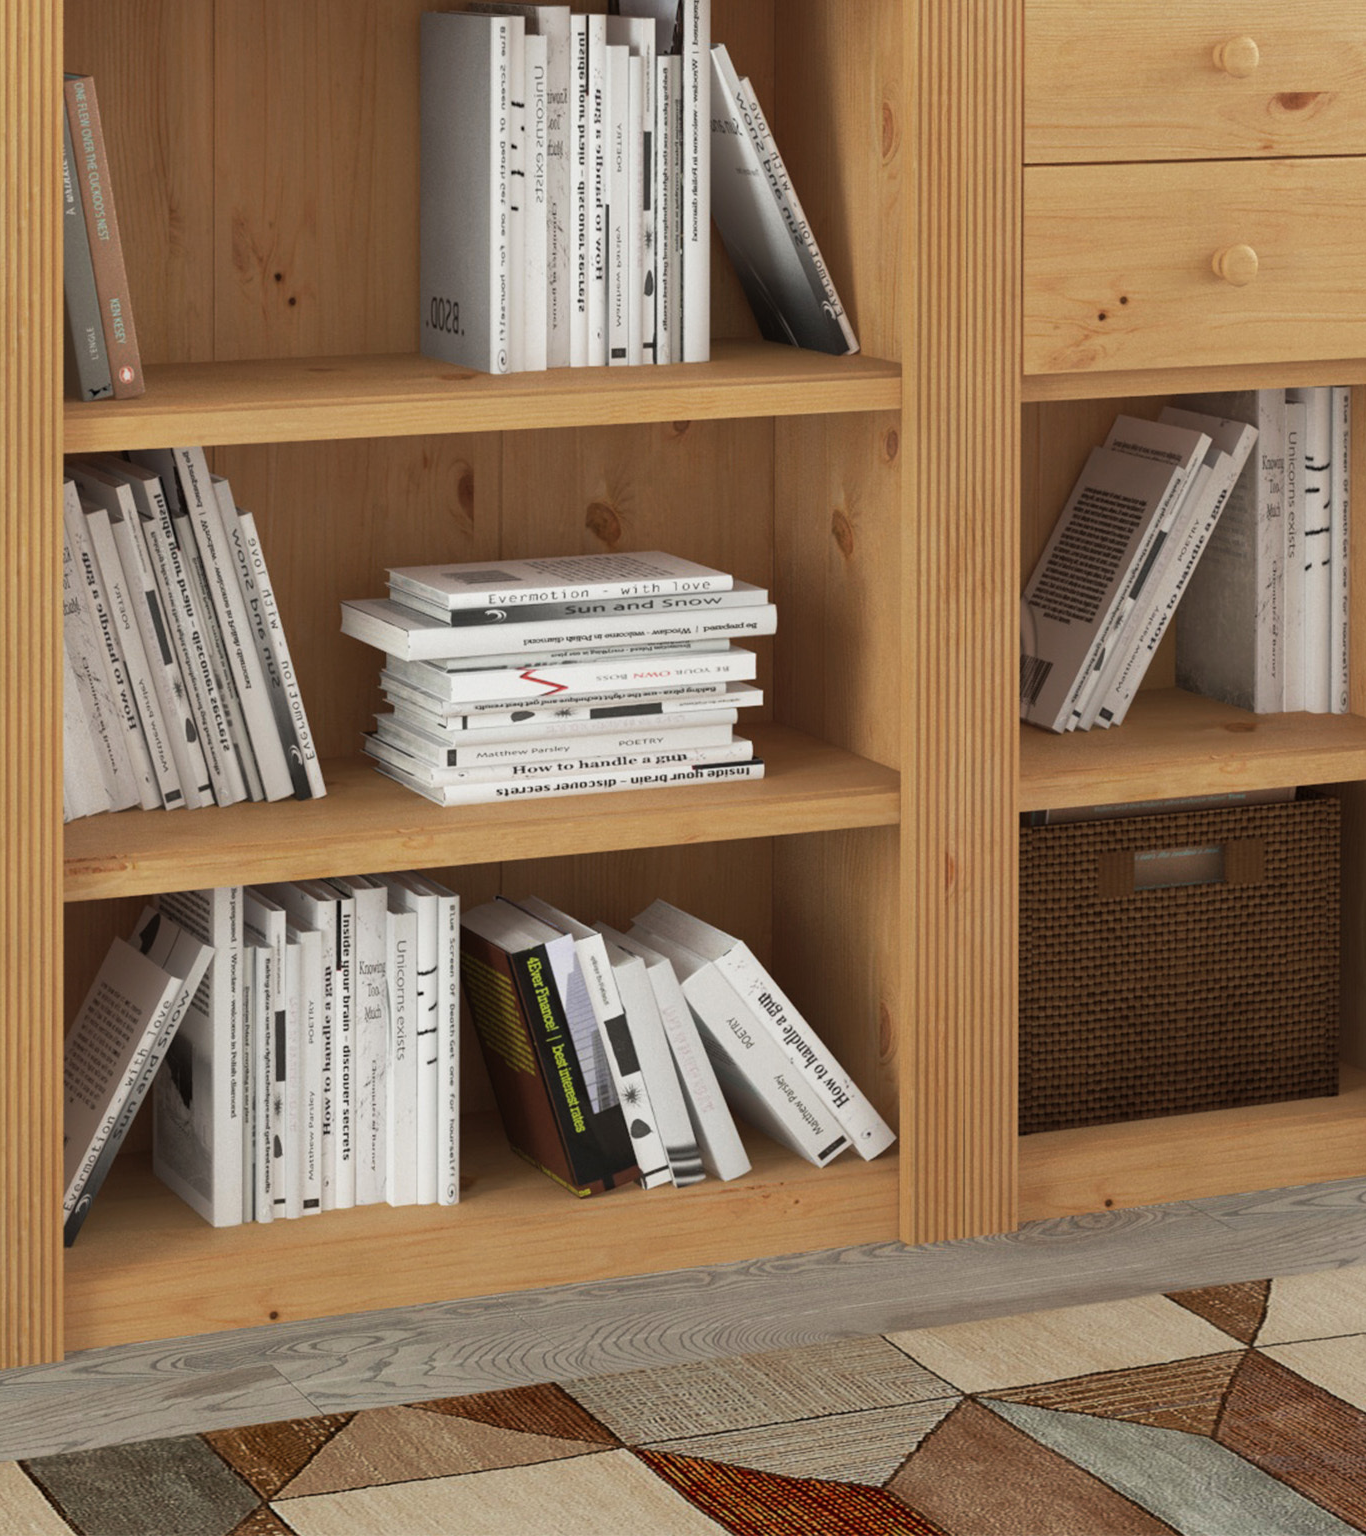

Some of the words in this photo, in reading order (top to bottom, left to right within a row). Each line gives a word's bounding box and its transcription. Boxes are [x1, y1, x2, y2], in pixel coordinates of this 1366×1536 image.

[73, 81, 86, 103] ONE
[77, 101, 92, 128] FLEW
[81, 127, 96, 154] OVER
[86, 153, 99, 171] THE
[88, 170, 108, 218] CUCKOO'S
[96, 218, 111, 242] NEST
[109, 297, 122, 318] KEN
[113, 316, 127, 345] KESEY
[1286, 431, 1298, 508] Unicorns
[1287, 511, 1297, 559] exists
[488, 589, 589, 605] Evermotion
[620, 583, 661, 596] with
[672, 581, 711, 592] love
[565, 604, 606, 615] Sun
[613, 599, 654, 611] and
[662, 597, 723, 608] Snow
[633, 670, 671, 679] OWN
[475, 749, 529, 759] Matthew
[530, 745, 571, 754] Parsley
[618, 737, 664, 747] POETRY
[553, 778, 617, 791] discover
[630, 774, 668, 785] brain
[669, 767, 705, 781] your
[707, 766, 750, 779] Inside
[496, 785, 551, 797] secrets
[340, 912, 351, 959] Inside
[339, 958, 350, 993] your
[526, 957, 544, 988] 4Ever
[342, 995, 351, 1032] brain
[534, 986, 560, 1033] Finance!
[775, 1014, 787, 1026] a
[726, 1017, 756, 1050] POETRY
[782, 1024, 818, 1070] handle
[112, 1100, 138, 1139] Sun
[137, 1054, 160, 1095] and
[157, 989, 190, 1048] Snow
[551, 1042, 569, 1070] best
[342, 1045, 351, 1107] discover
[813, 1064, 829, 1080] to
[558, 1066, 580, 1108] interest
[773, 1074, 798, 1104] Parsley
[823, 1078, 850, 1109] How
[569, 1105, 586, 1133] rates
[794, 1100, 824, 1136] Matthew
[342, 1108, 351, 1161] secrets
